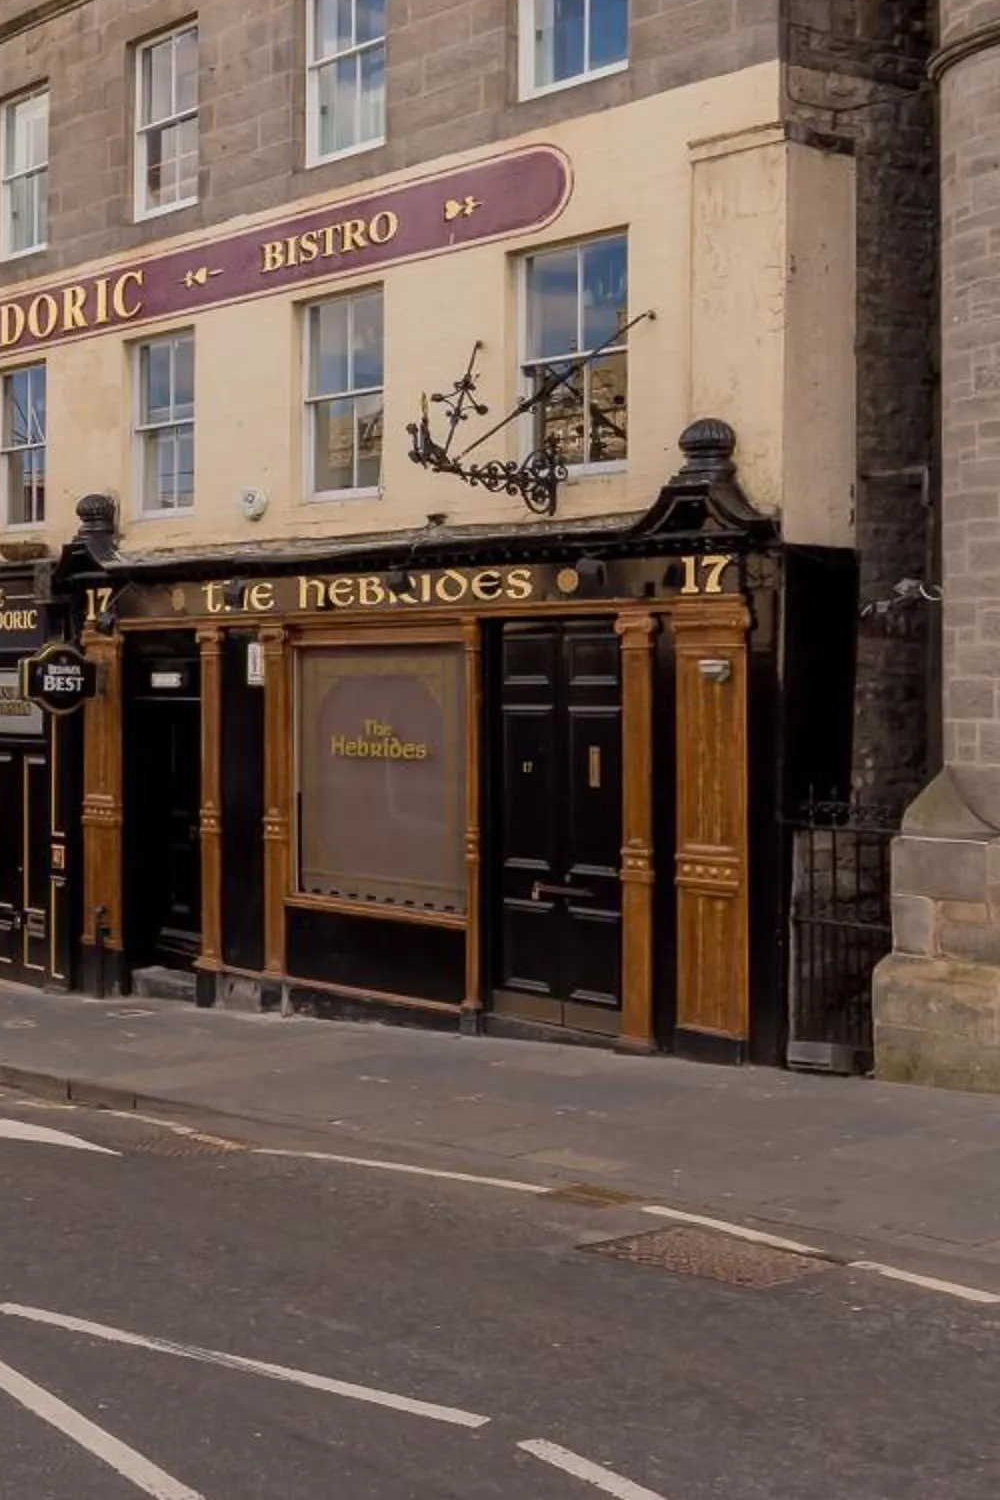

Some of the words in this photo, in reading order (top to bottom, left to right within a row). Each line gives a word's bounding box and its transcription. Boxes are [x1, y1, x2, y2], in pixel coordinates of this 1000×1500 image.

[0, 271, 145, 347] DORIC
[260, 211, 399, 274] BISTRO
[681, 555, 729, 594] 17
[86, 587, 113, 621] 17
[43, 675, 85, 692] BEST
[364, 719, 394, 736] The
